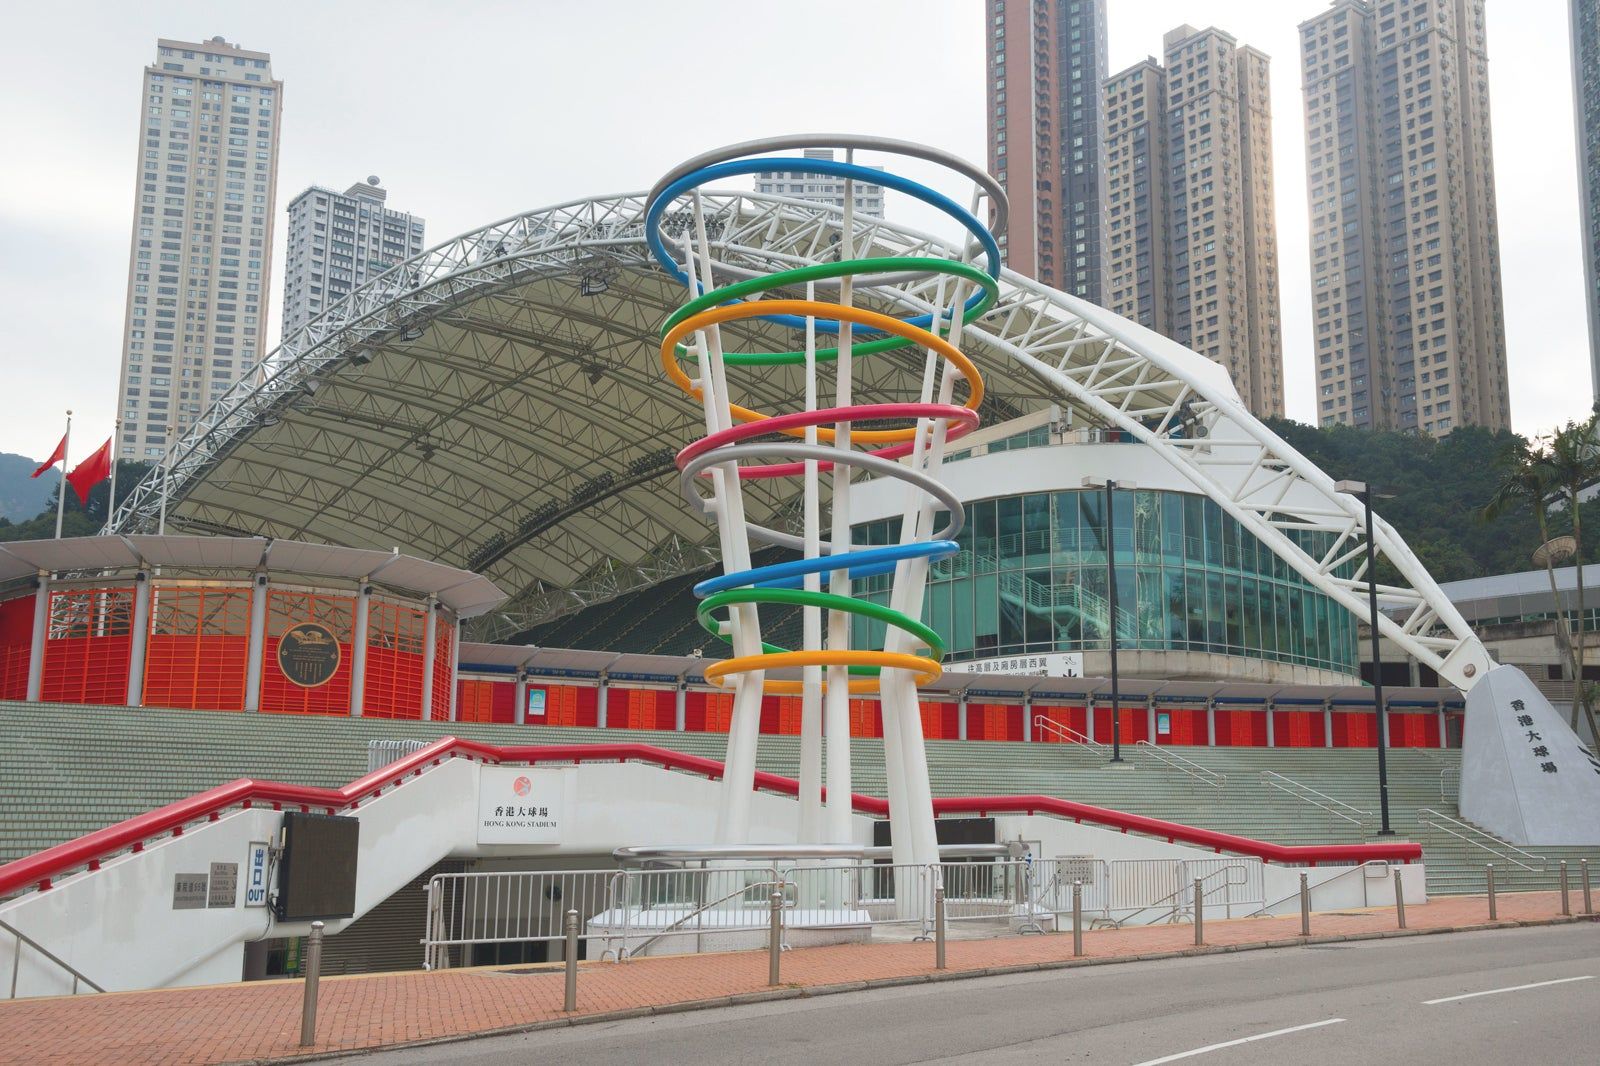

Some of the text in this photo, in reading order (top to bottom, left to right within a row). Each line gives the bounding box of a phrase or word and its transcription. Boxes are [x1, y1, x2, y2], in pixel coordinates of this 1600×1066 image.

[1510, 699, 1558, 773] 香港大球場
[495, 806, 549, 817] 香港大球場
[506, 820, 526, 828] KONG
[253, 849, 264, 885] 出口
[248, 889, 264, 901] OUT
